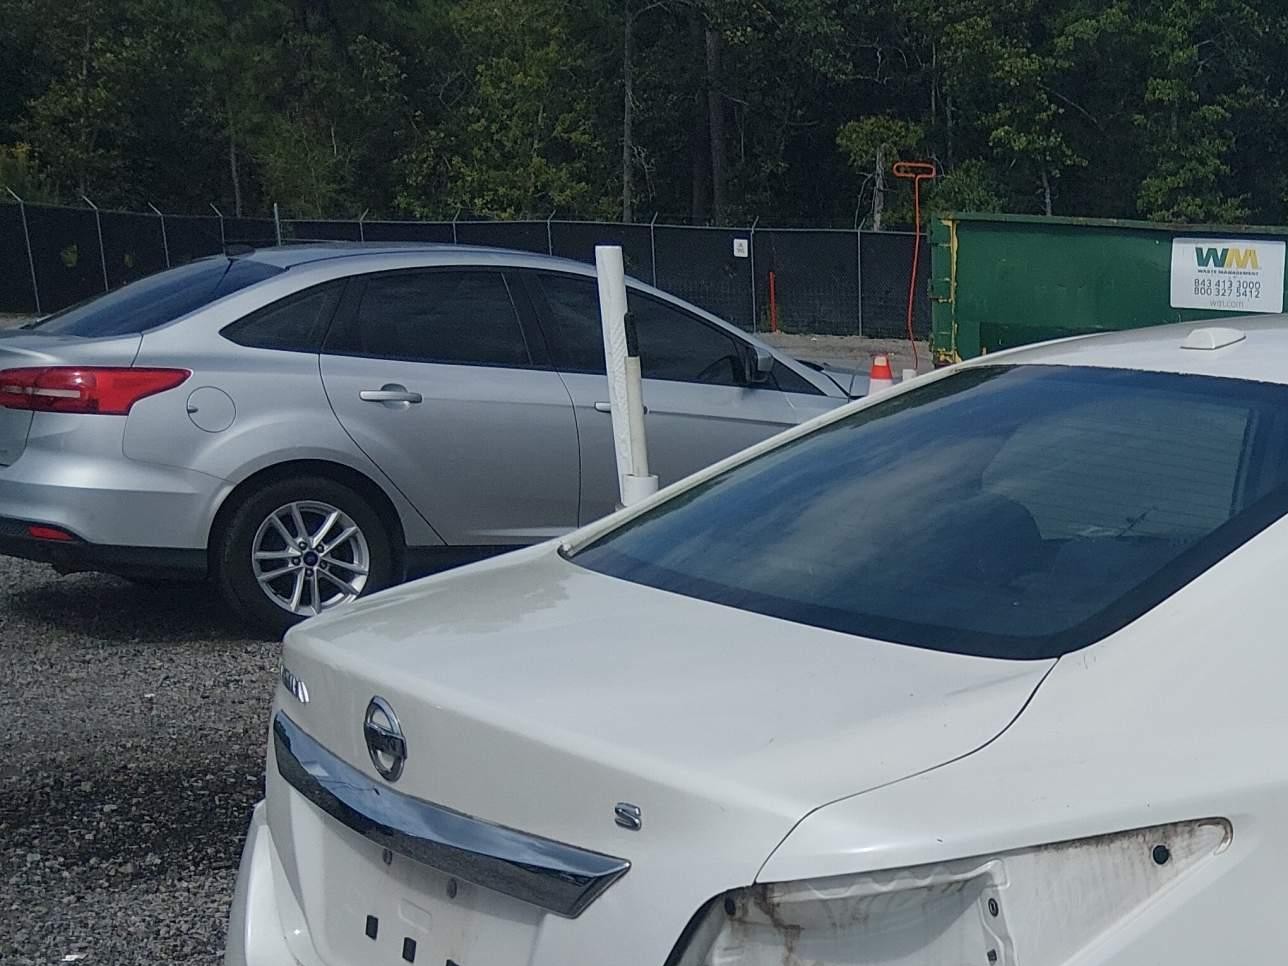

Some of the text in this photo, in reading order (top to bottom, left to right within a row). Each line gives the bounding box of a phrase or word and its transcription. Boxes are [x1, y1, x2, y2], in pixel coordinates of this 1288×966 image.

[1195, 247, 1259, 269] WM
[1194, 278, 1261, 290] 843 413 3000
[1194, 287, 1261, 299] 800 327 5412
[614, 801, 642, 831] S
